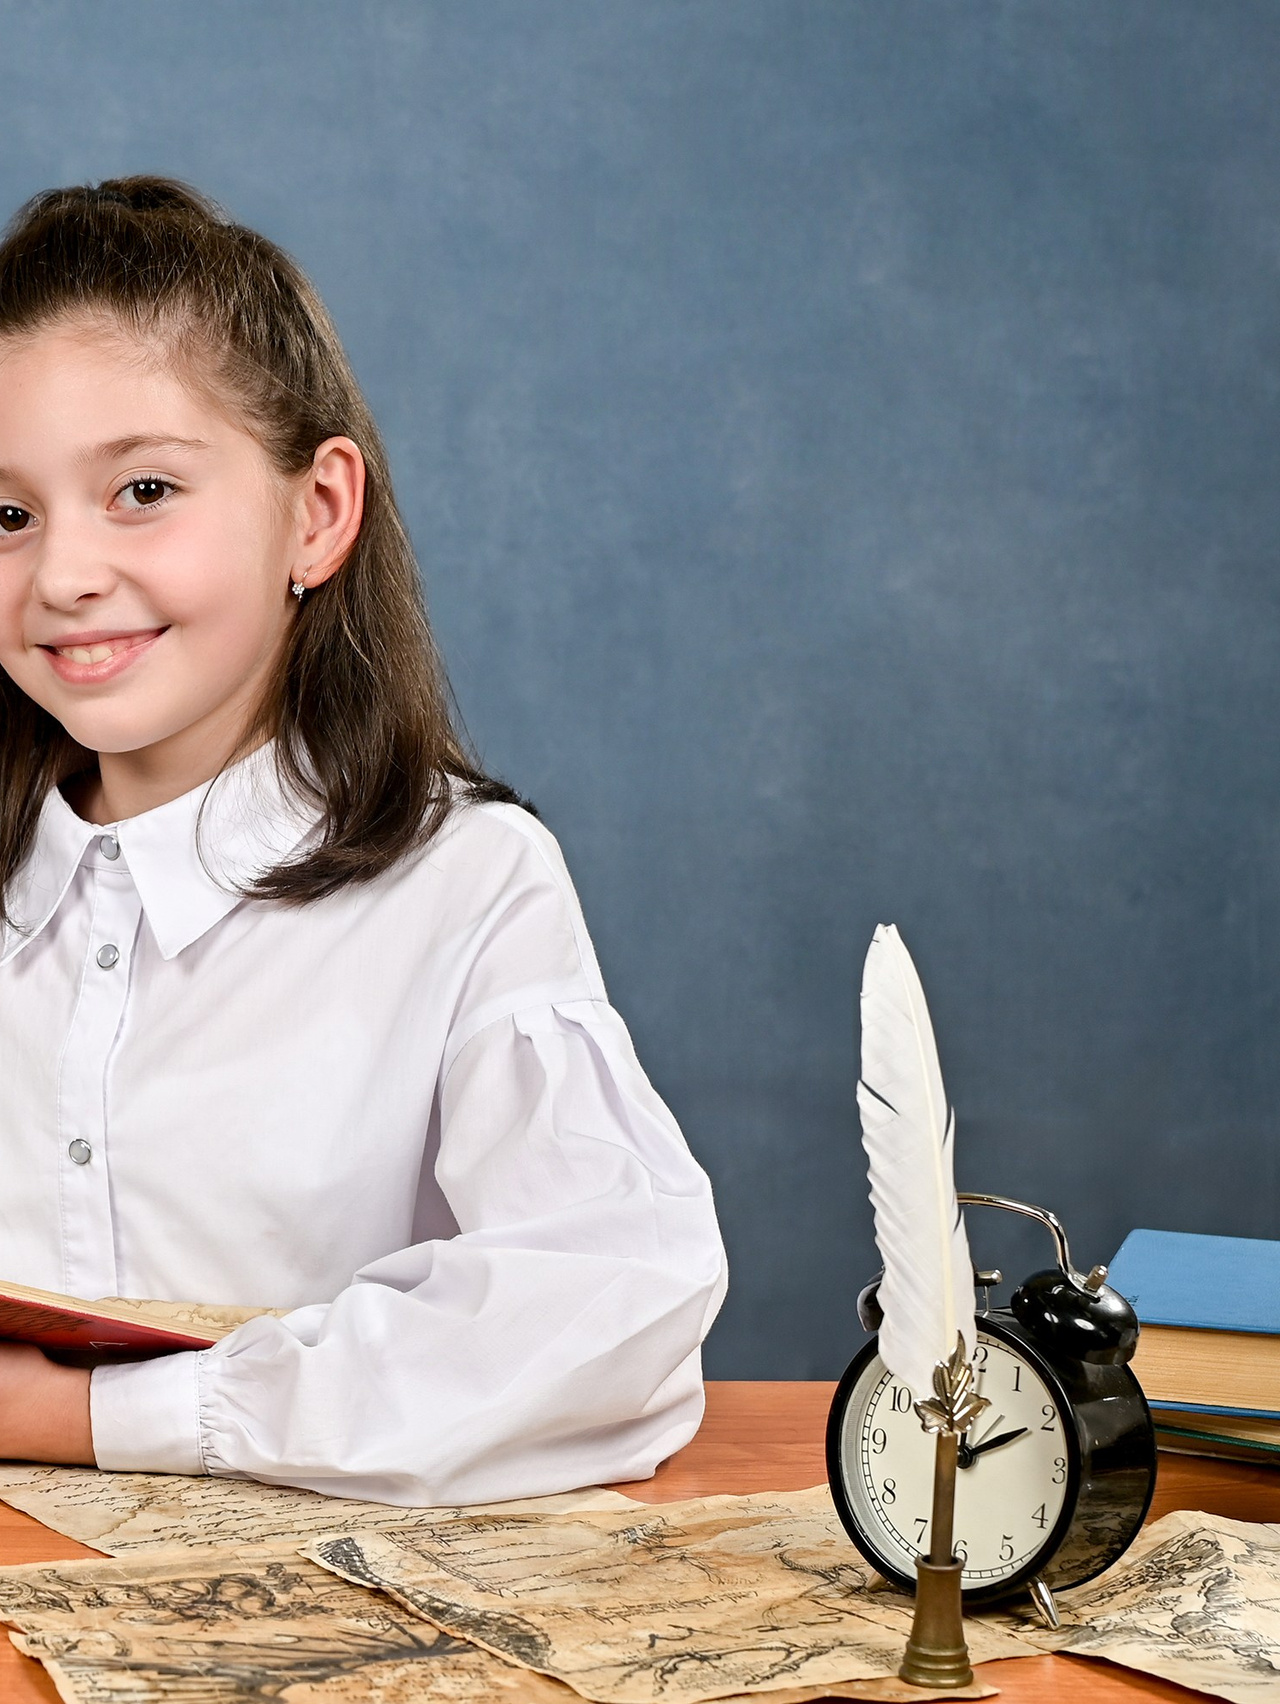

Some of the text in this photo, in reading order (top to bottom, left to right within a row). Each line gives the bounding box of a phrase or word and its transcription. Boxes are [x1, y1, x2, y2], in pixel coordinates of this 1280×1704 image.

[1012, 1366, 1022, 1392] 1
[889, 1386, 912, 1413] 10
[1041, 1404, 1056, 1432] 2
[872, 1428, 887, 1454] 9
[1052, 1457, 1066, 1485] 3
[882, 1478, 897, 1504] 8
[1031, 1503, 1049, 1530] 4
[913, 1518, 929, 1544] 7
[953, 1539, 968, 1563] 6
[999, 1534, 1015, 1561] 5
